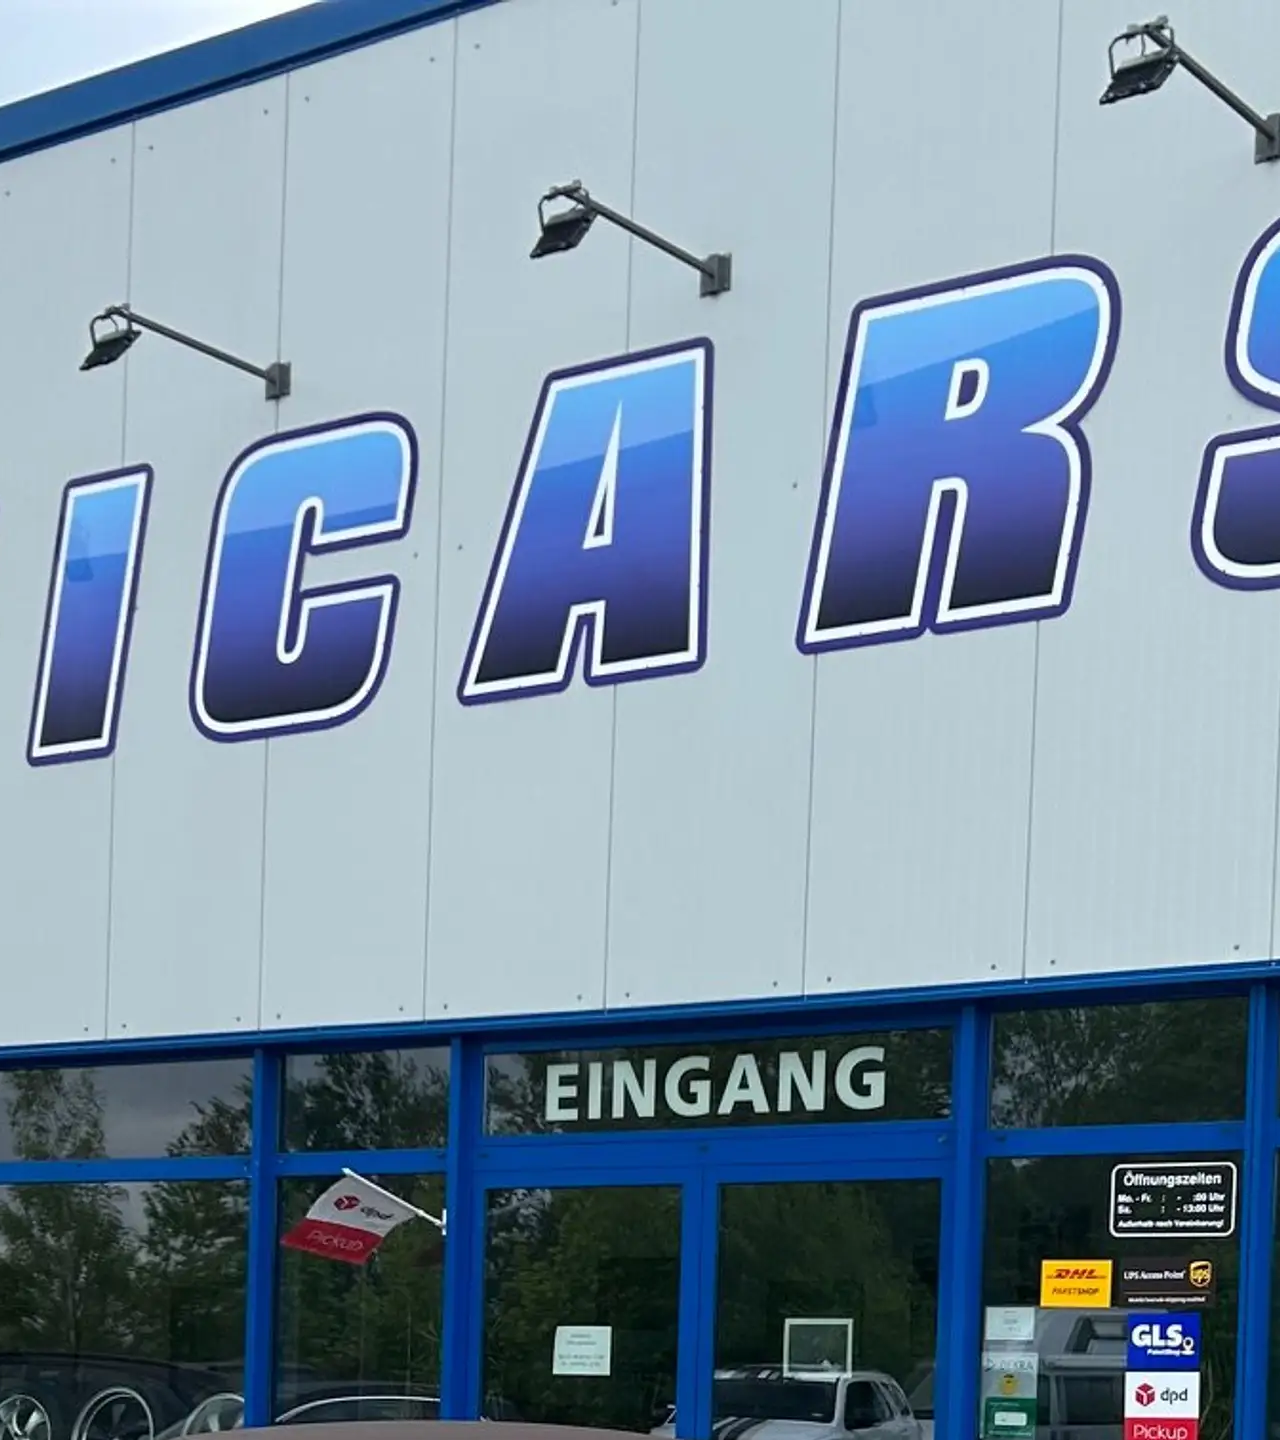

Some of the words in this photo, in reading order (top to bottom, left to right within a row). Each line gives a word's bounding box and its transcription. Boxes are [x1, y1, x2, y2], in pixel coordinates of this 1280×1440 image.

[544, 1045, 887, 1122] EINGANG
[1123, 1169, 1222, 1188] Öffnungszeiten
[1208, 1192, 1225, 1202] Uhr
[1208, 1204, 1225, 1213] Uhr
[305, 1230, 365, 1251] Pickup
[1054, 1268, 1097, 1280] DHL
[1131, 1323, 1183, 1347] GLS
[1160, 1388, 1188, 1405] dpd
